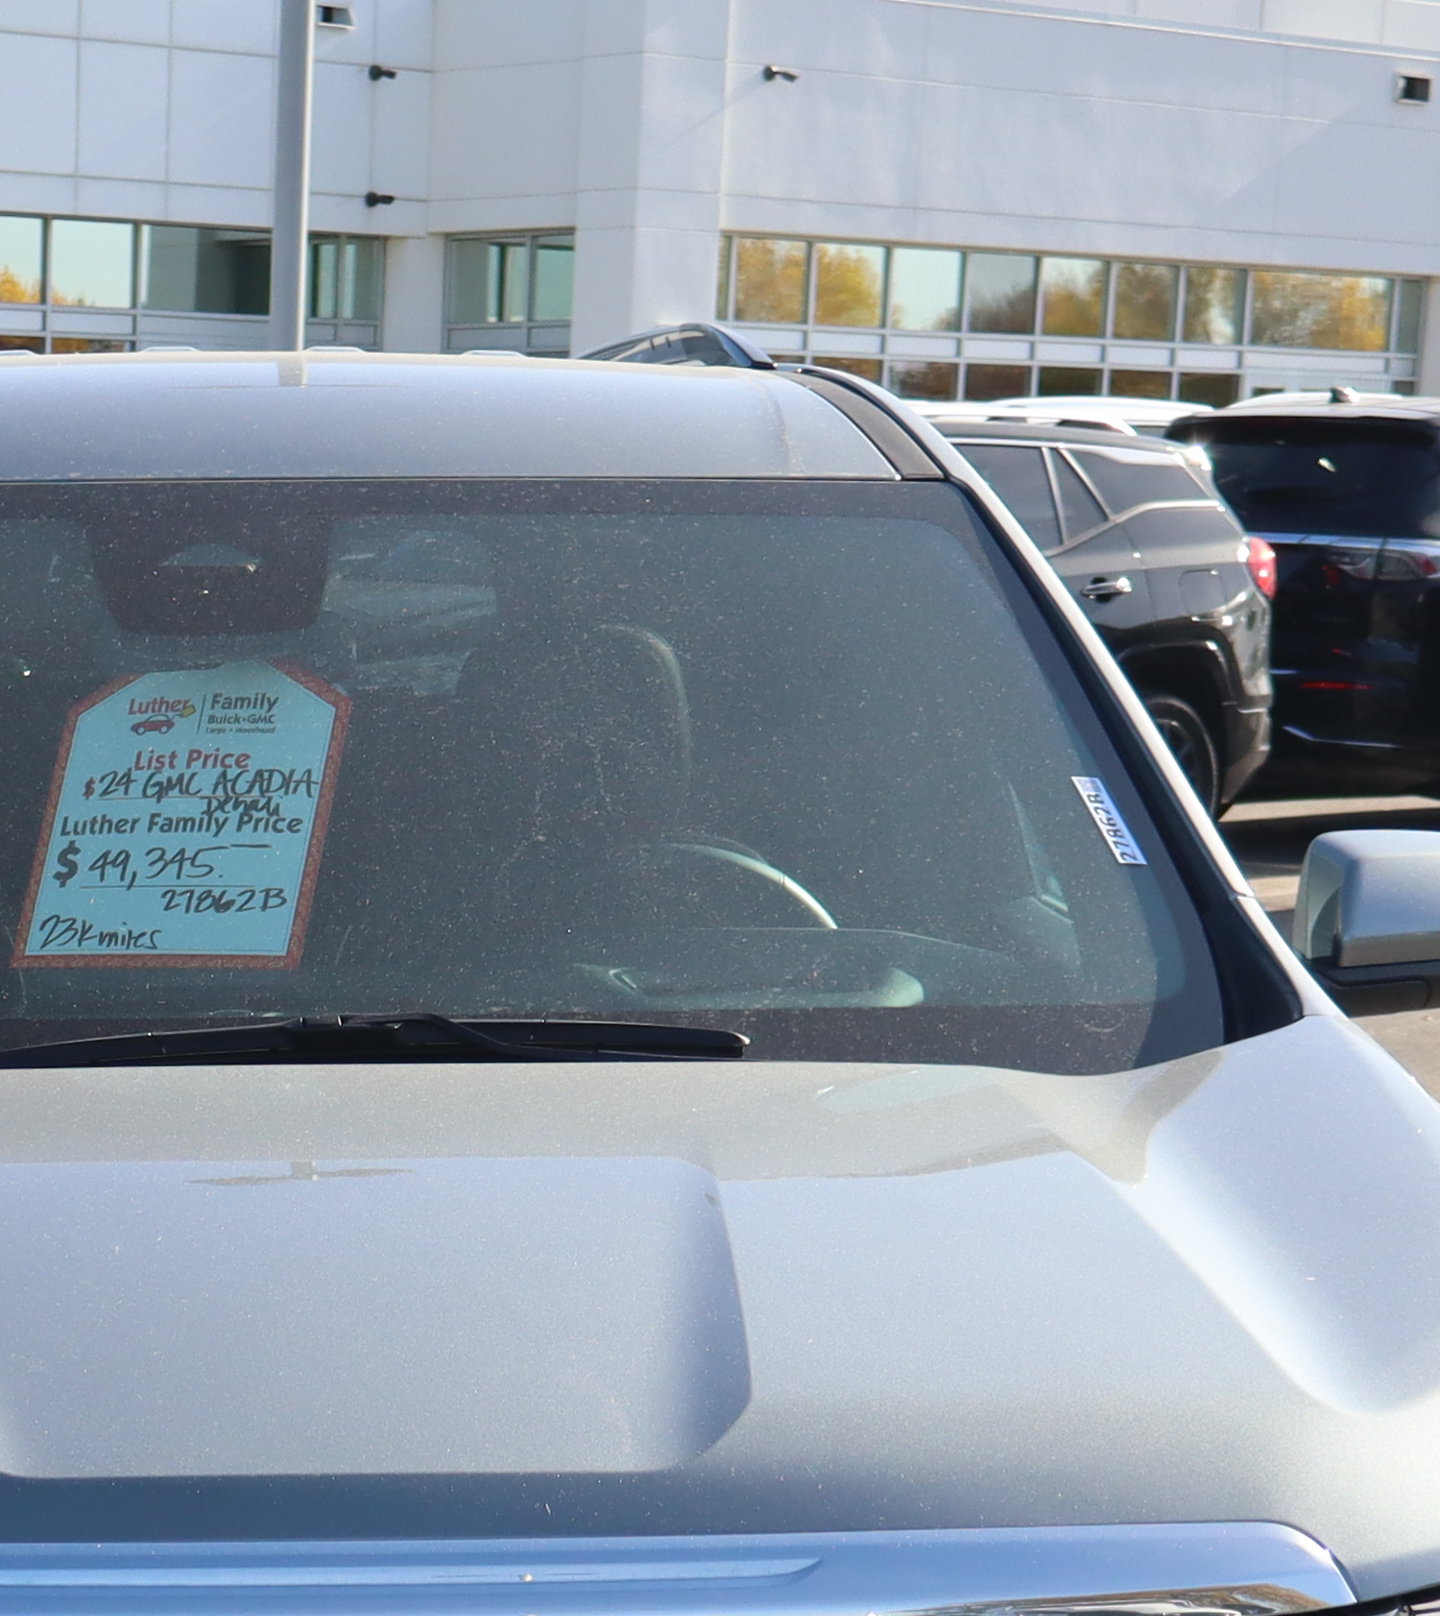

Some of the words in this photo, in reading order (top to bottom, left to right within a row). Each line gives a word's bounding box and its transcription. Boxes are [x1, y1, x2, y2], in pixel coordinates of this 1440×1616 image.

[128, 696, 193, 715] Luther
[210, 692, 280, 714] Family
[208, 714, 242, 725] Buick
[247, 714, 276, 724] GMC
[134, 749, 178, 771] List
[185, 748, 252, 770] Price
[142, 769, 203, 803] GMC
[211, 768, 320, 799] ACADIA
[60, 813, 141, 837] Luther
[147, 811, 229, 838] Family
[235, 811, 304, 834] Price
